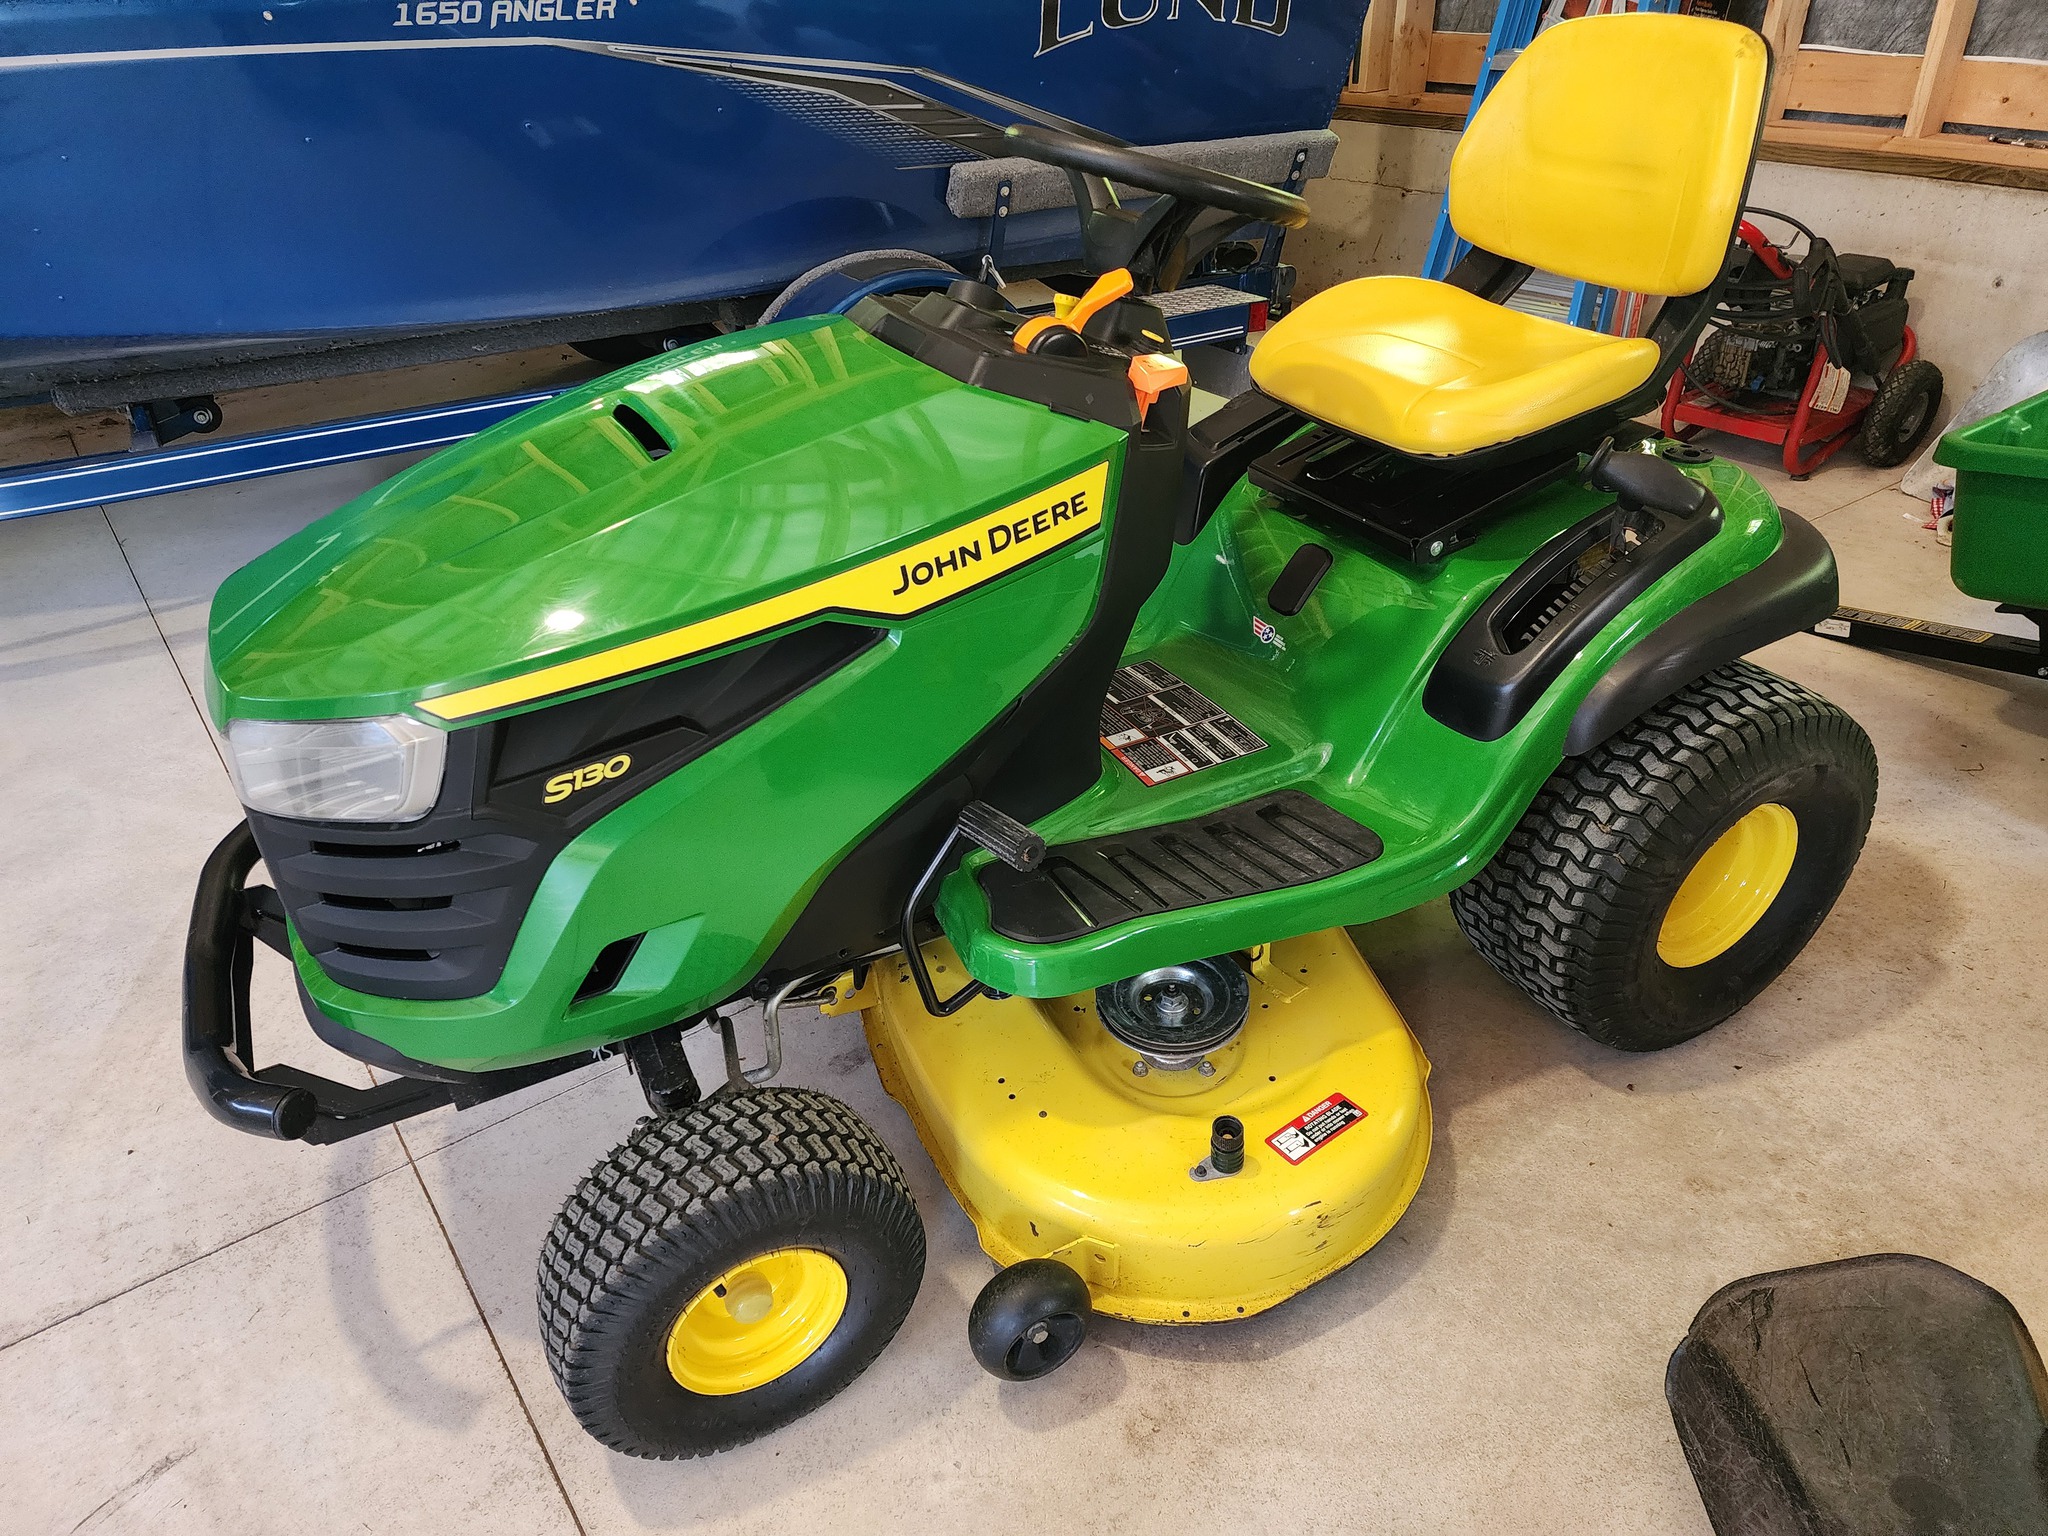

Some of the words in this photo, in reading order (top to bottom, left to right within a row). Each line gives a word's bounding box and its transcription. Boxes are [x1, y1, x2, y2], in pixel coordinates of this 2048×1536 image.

[392, 0, 482, 27] 1650
[490, 0, 617, 30] ANGLER
[892, 540, 982, 596] JOHN
[987, 491, 1089, 555] DEERE
[543, 754, 632, 805] S130
[1309, 1101, 1333, 1119] DANGER
[1324, 1115, 1337, 1124] hands
[1304, 1114, 1328, 1131] ROTATING
